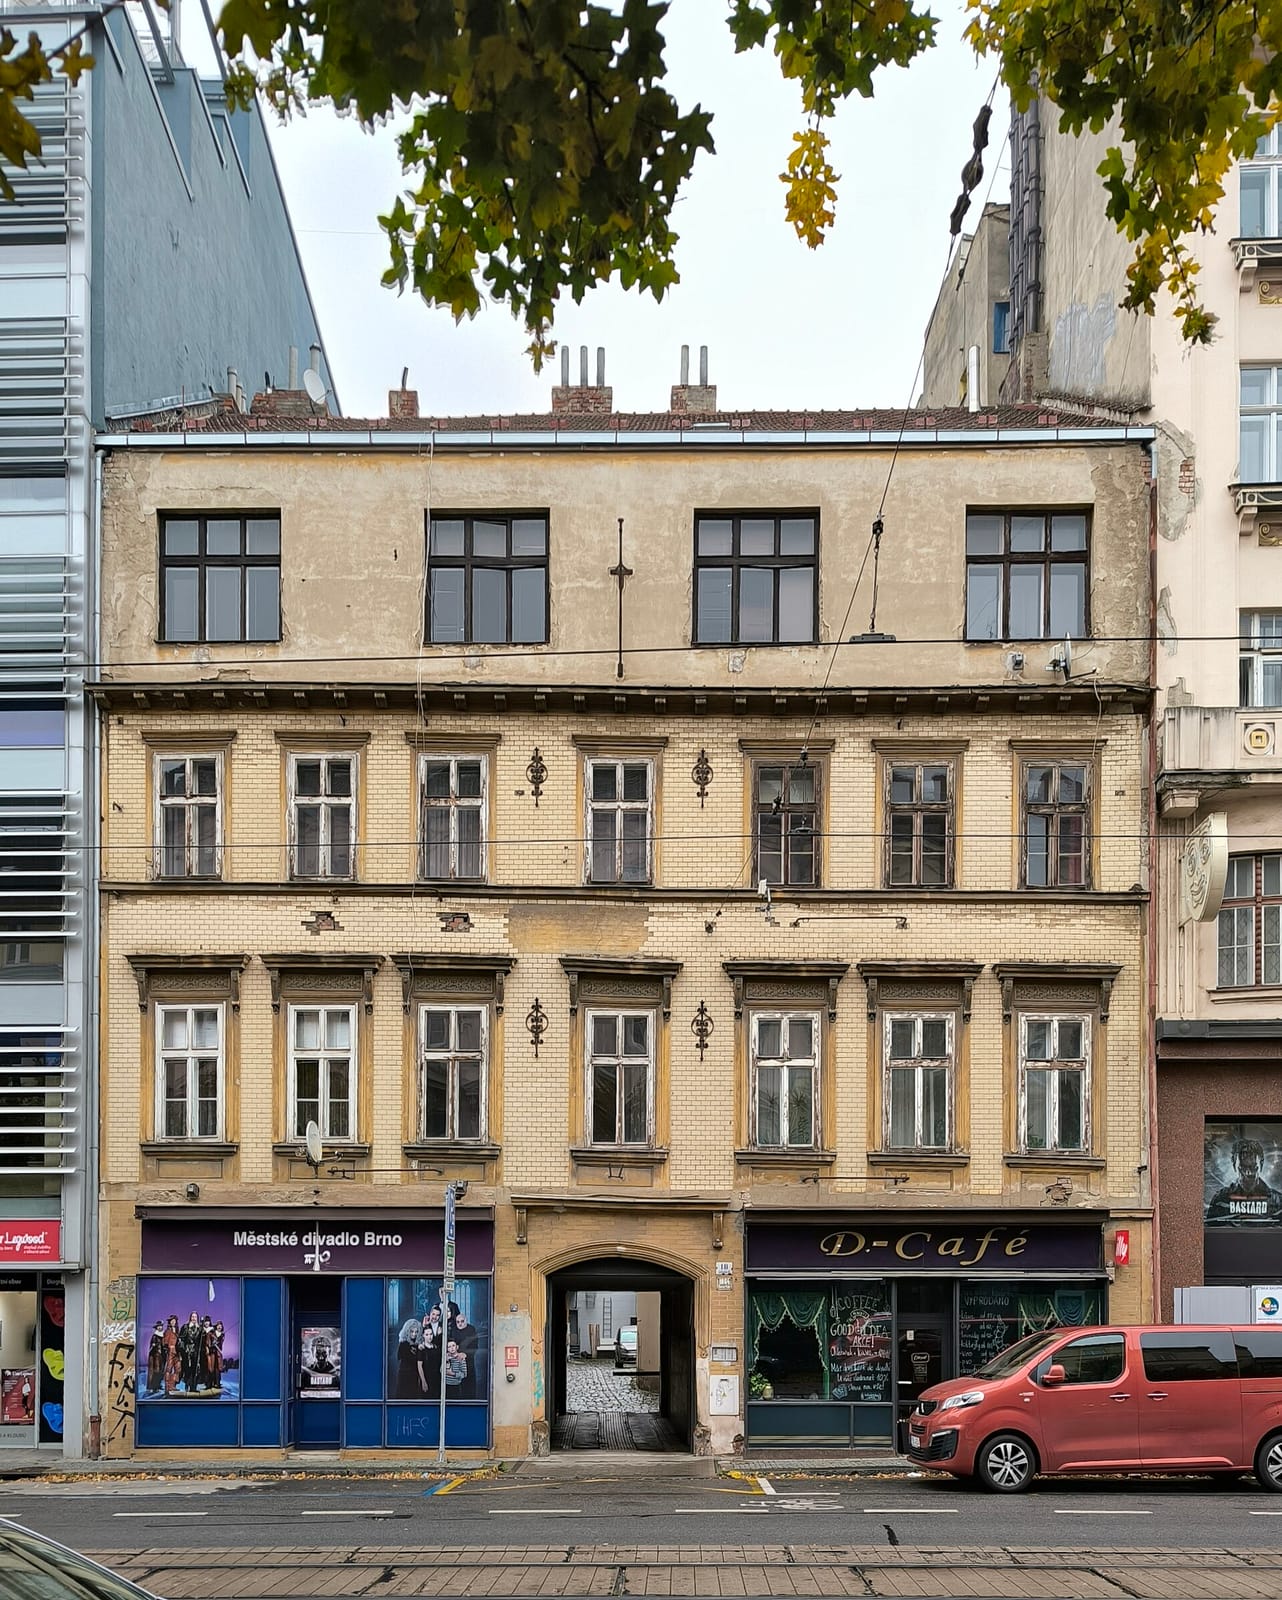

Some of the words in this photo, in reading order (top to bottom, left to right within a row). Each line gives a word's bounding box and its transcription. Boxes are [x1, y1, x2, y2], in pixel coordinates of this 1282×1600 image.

[1229, 1201, 1268, 1215] BASTARD
[233, 1231, 298, 1246] Městské
[302, 1231, 360, 1246] divadlo
[364, 1232, 402, 1246] Brno
[830, 1323, 855, 1337] GOOD
